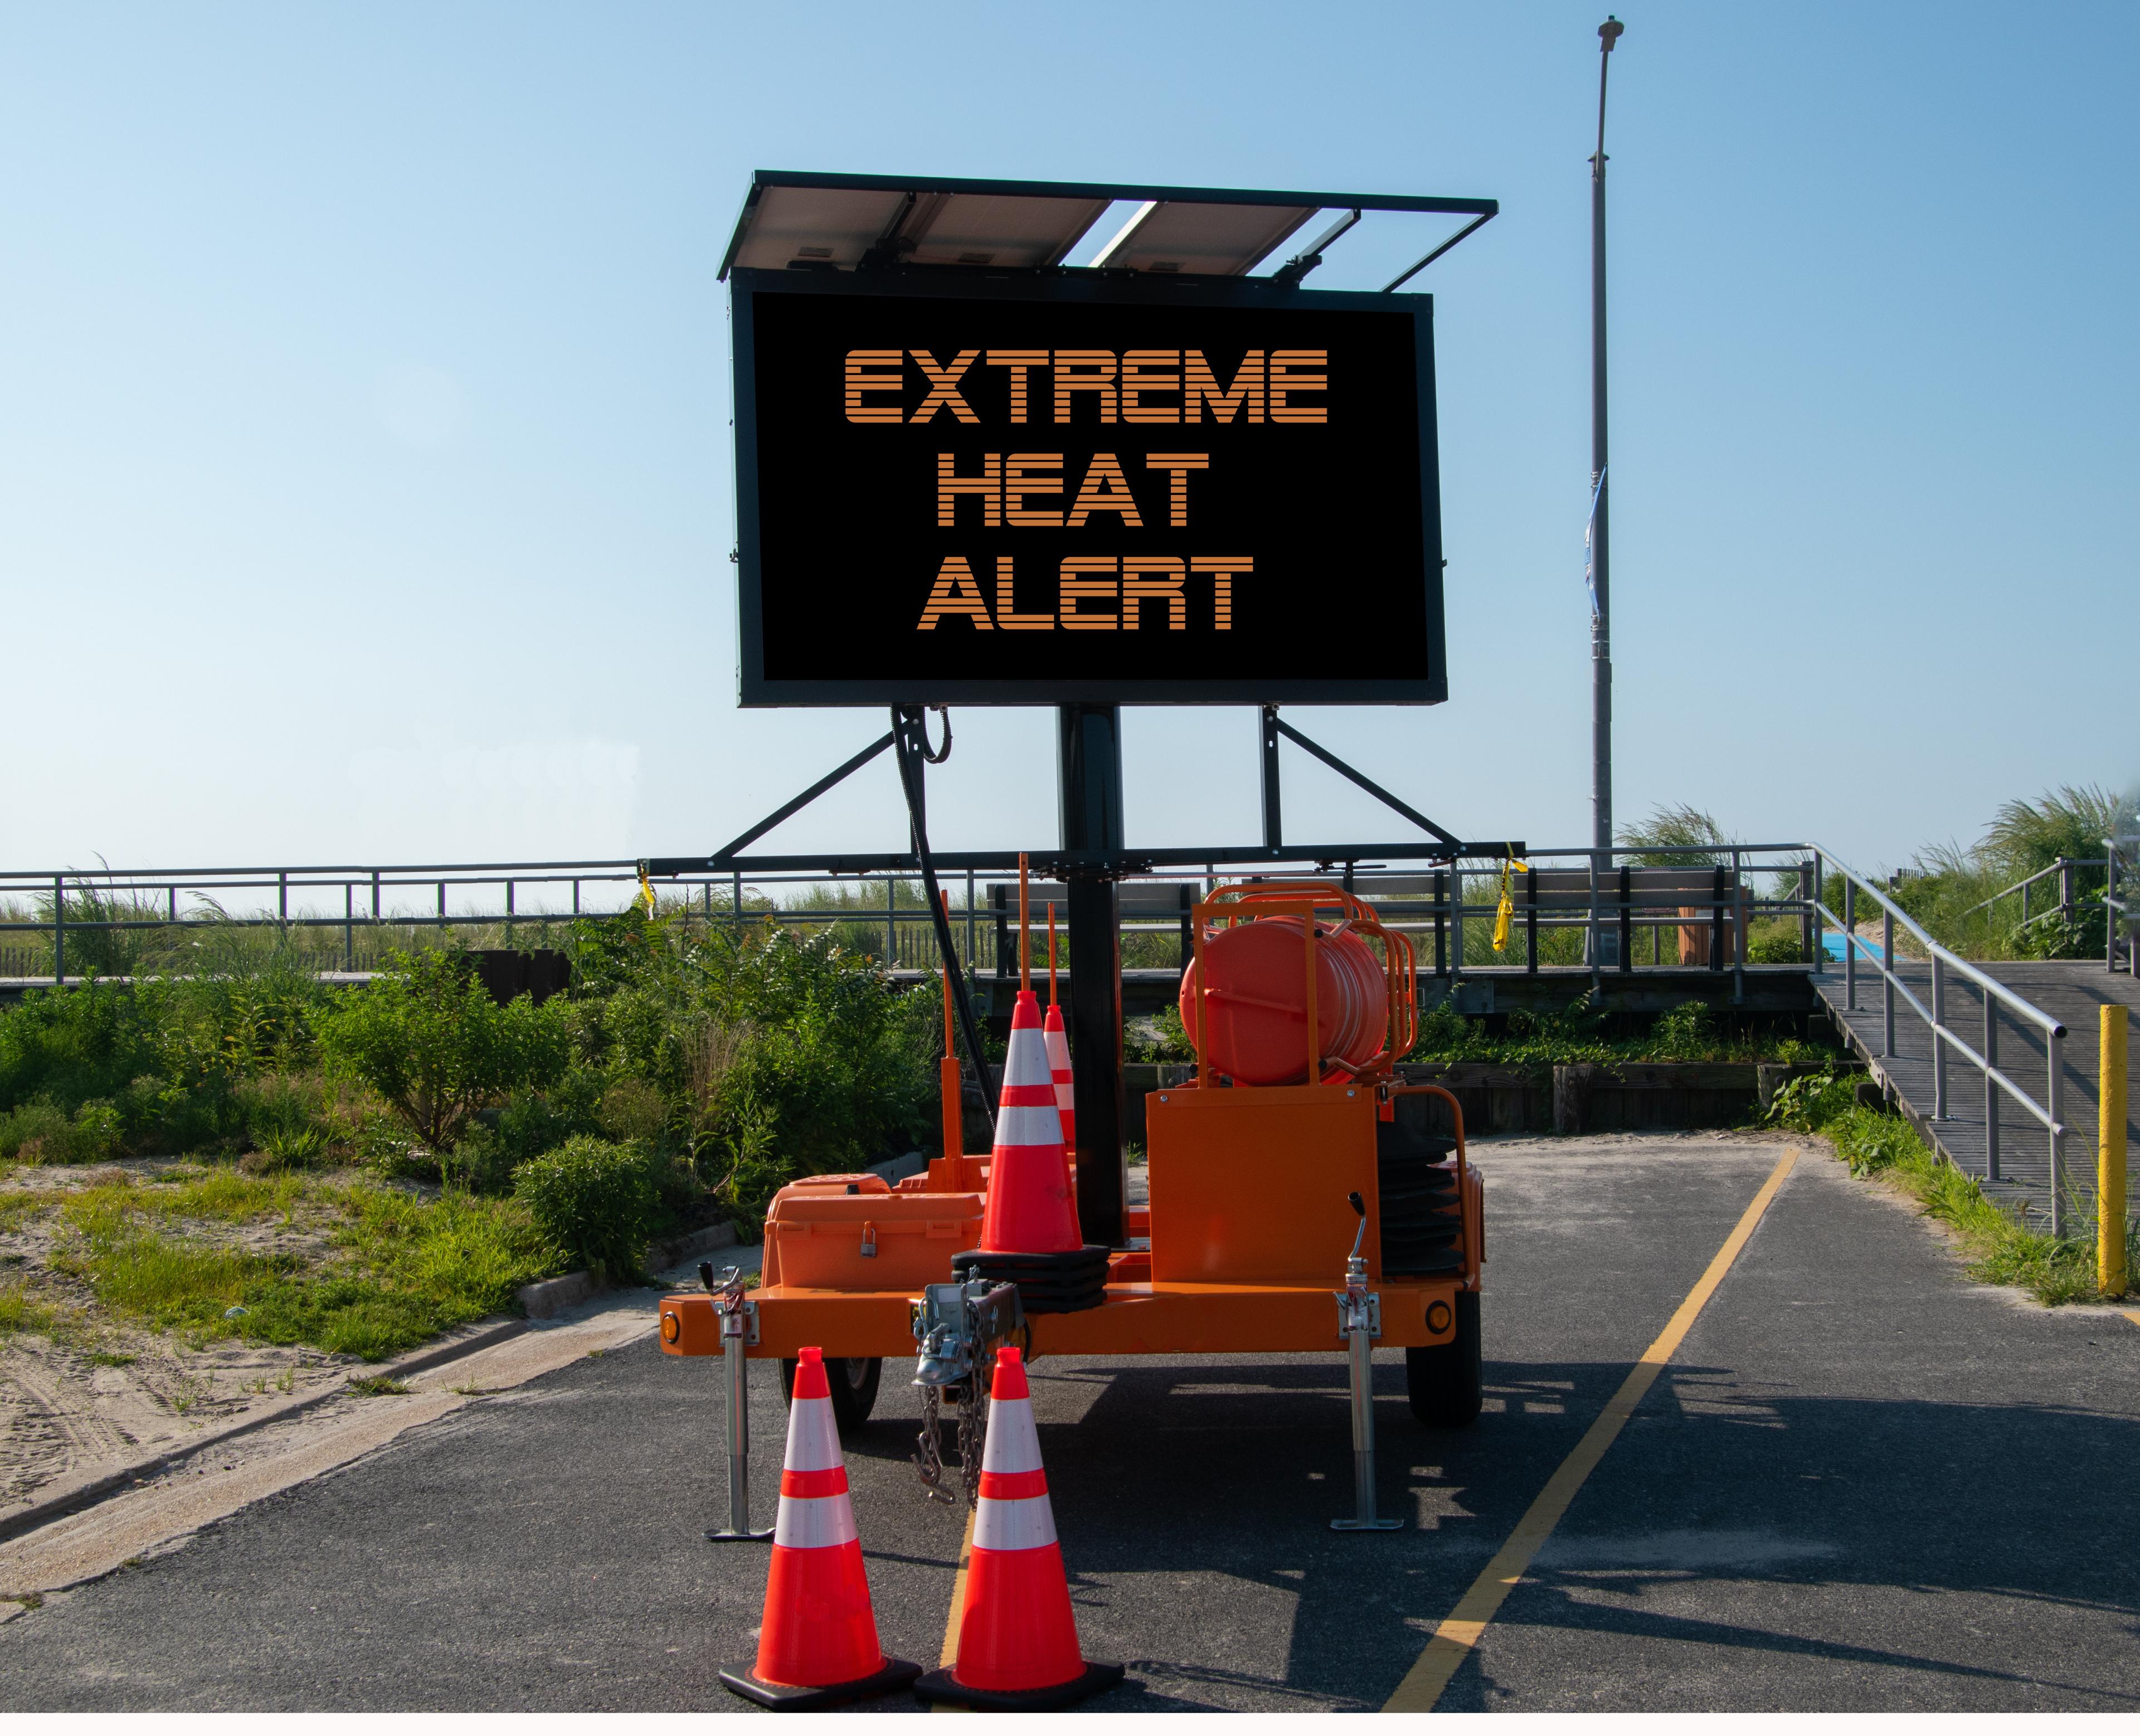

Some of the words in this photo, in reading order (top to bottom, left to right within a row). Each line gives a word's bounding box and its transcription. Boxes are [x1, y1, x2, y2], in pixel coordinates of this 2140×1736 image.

[845, 350, 1327, 422] EXTREME
[938, 454, 1209, 526] HEAT
[917, 557, 1253, 629] ALERT
